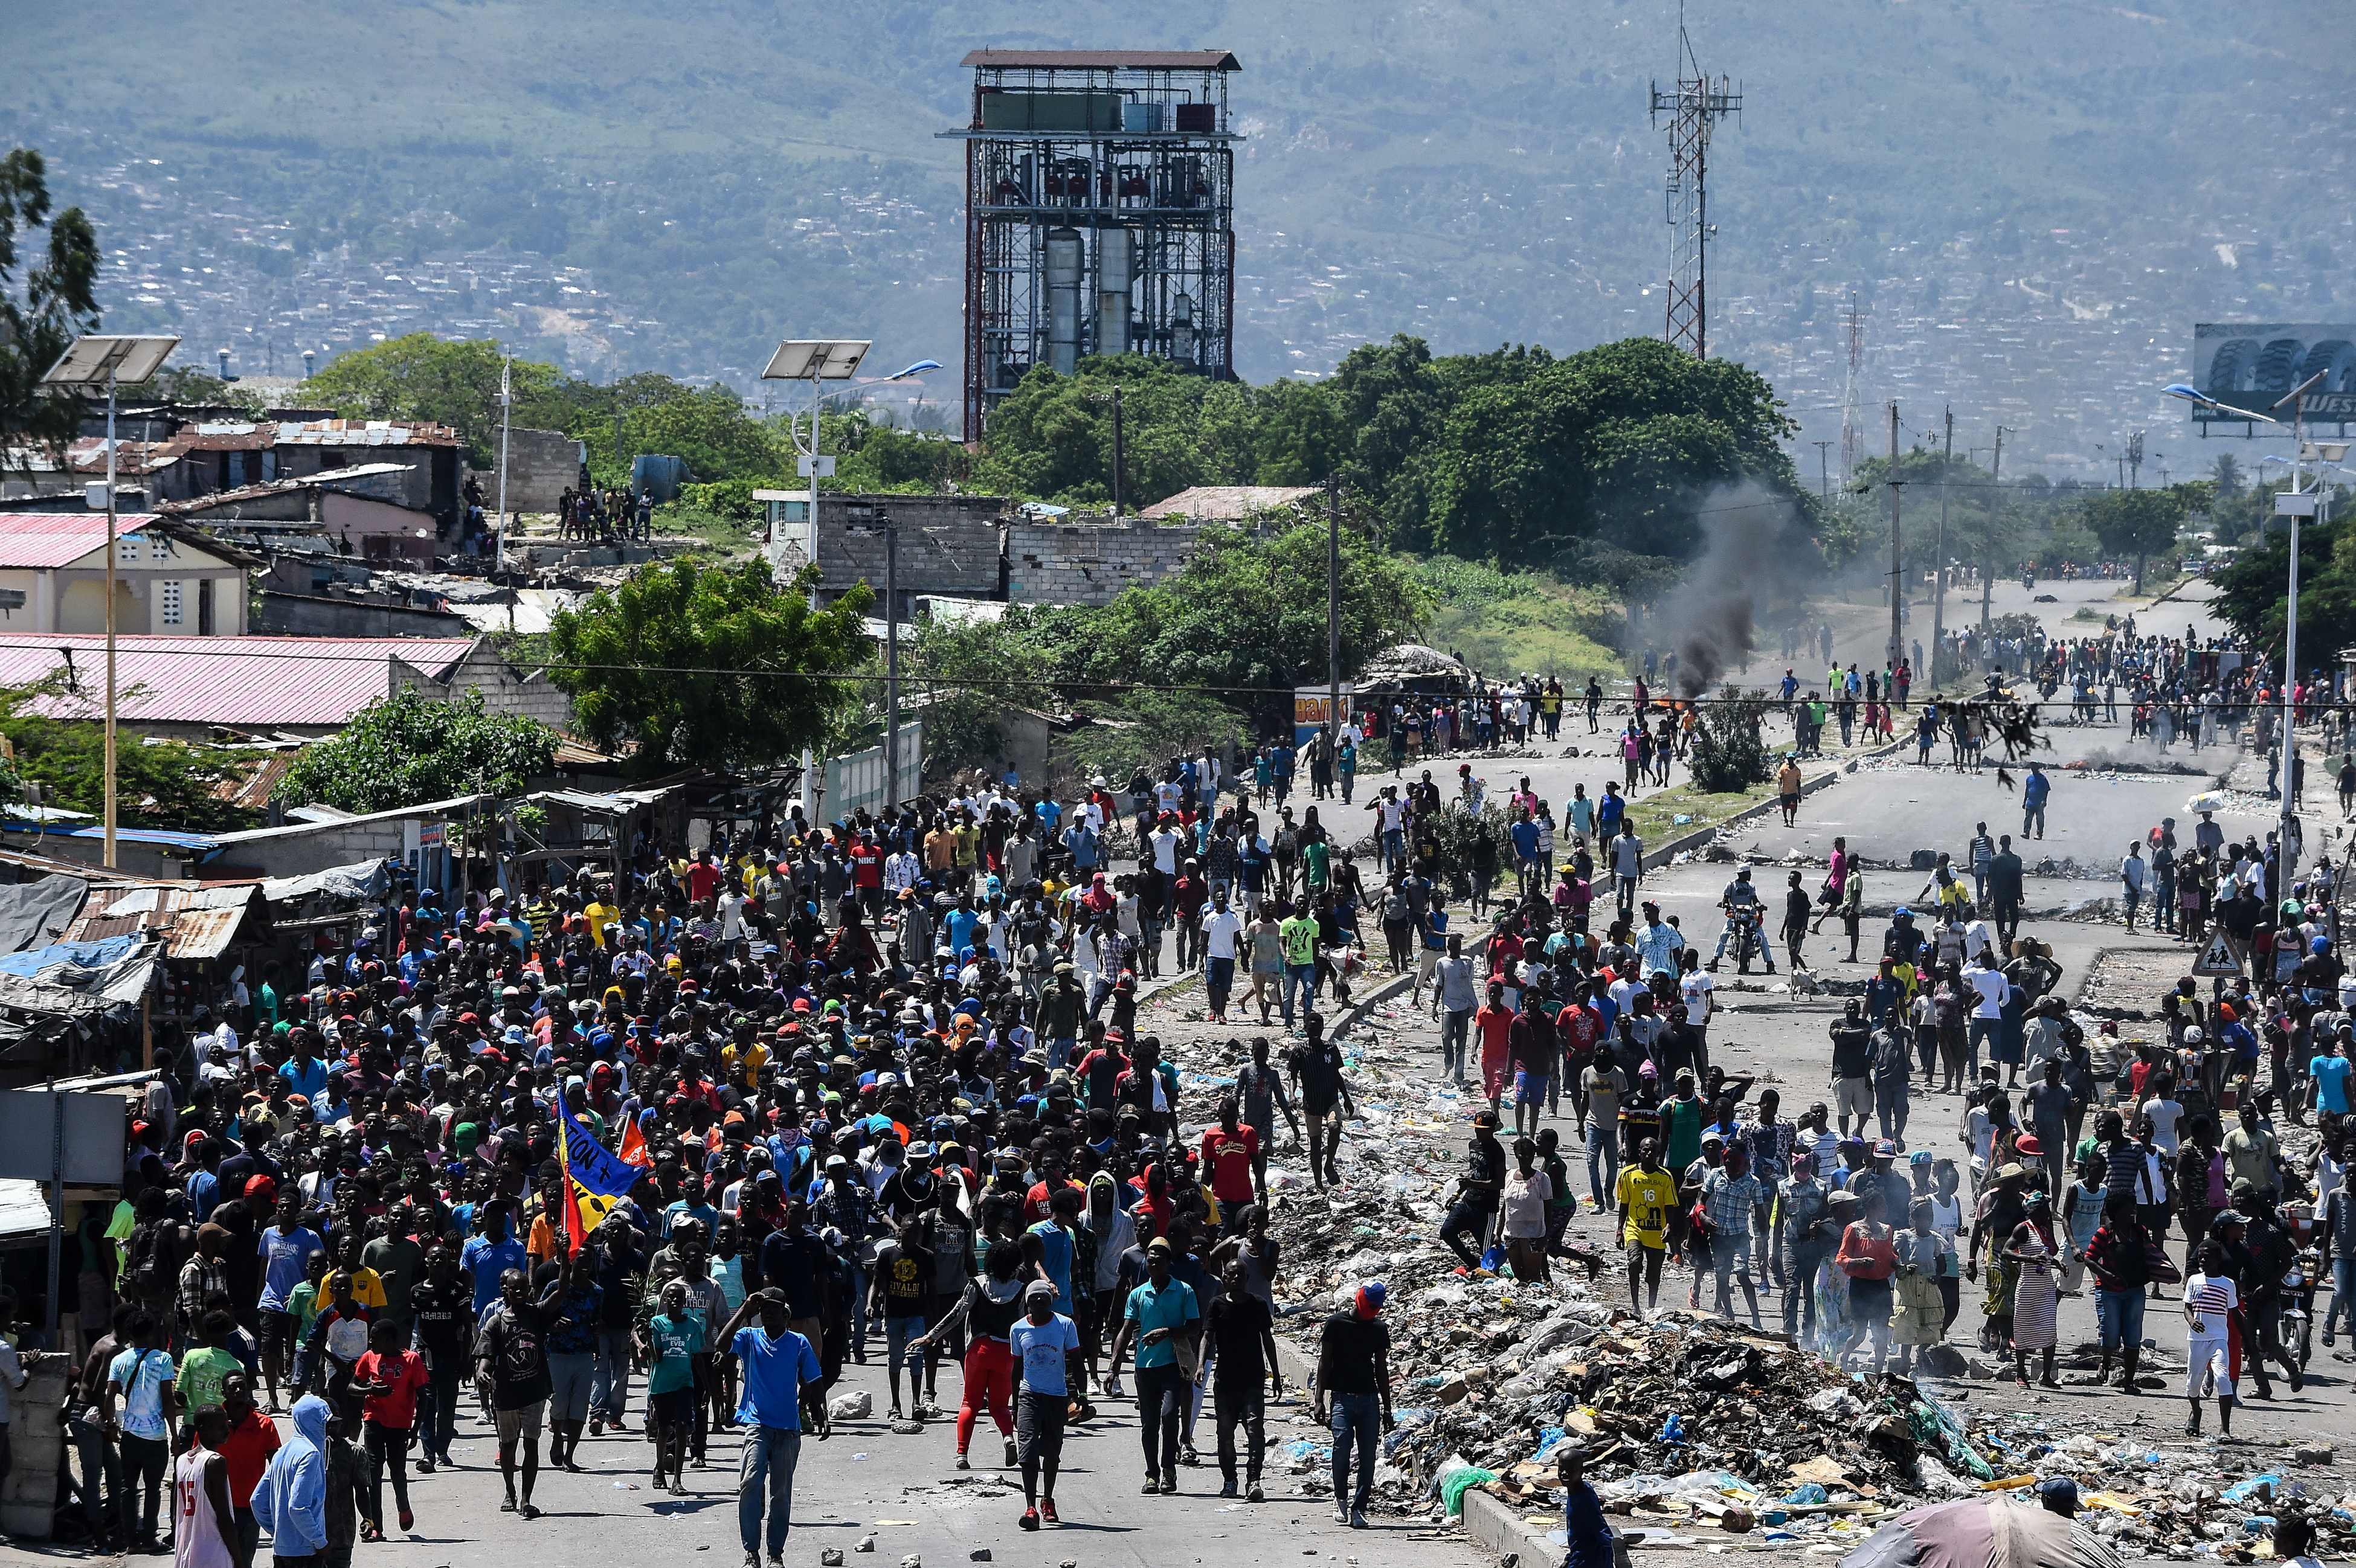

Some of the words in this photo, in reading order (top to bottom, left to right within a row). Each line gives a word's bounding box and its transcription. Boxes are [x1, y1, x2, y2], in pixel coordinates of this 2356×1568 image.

[2300, 394, 2356, 413] WES
[1643, 1189, 1655, 1202] 16
[1637, 1219, 1661, 1229] TIME
[178, 1481, 196, 1516] 15
